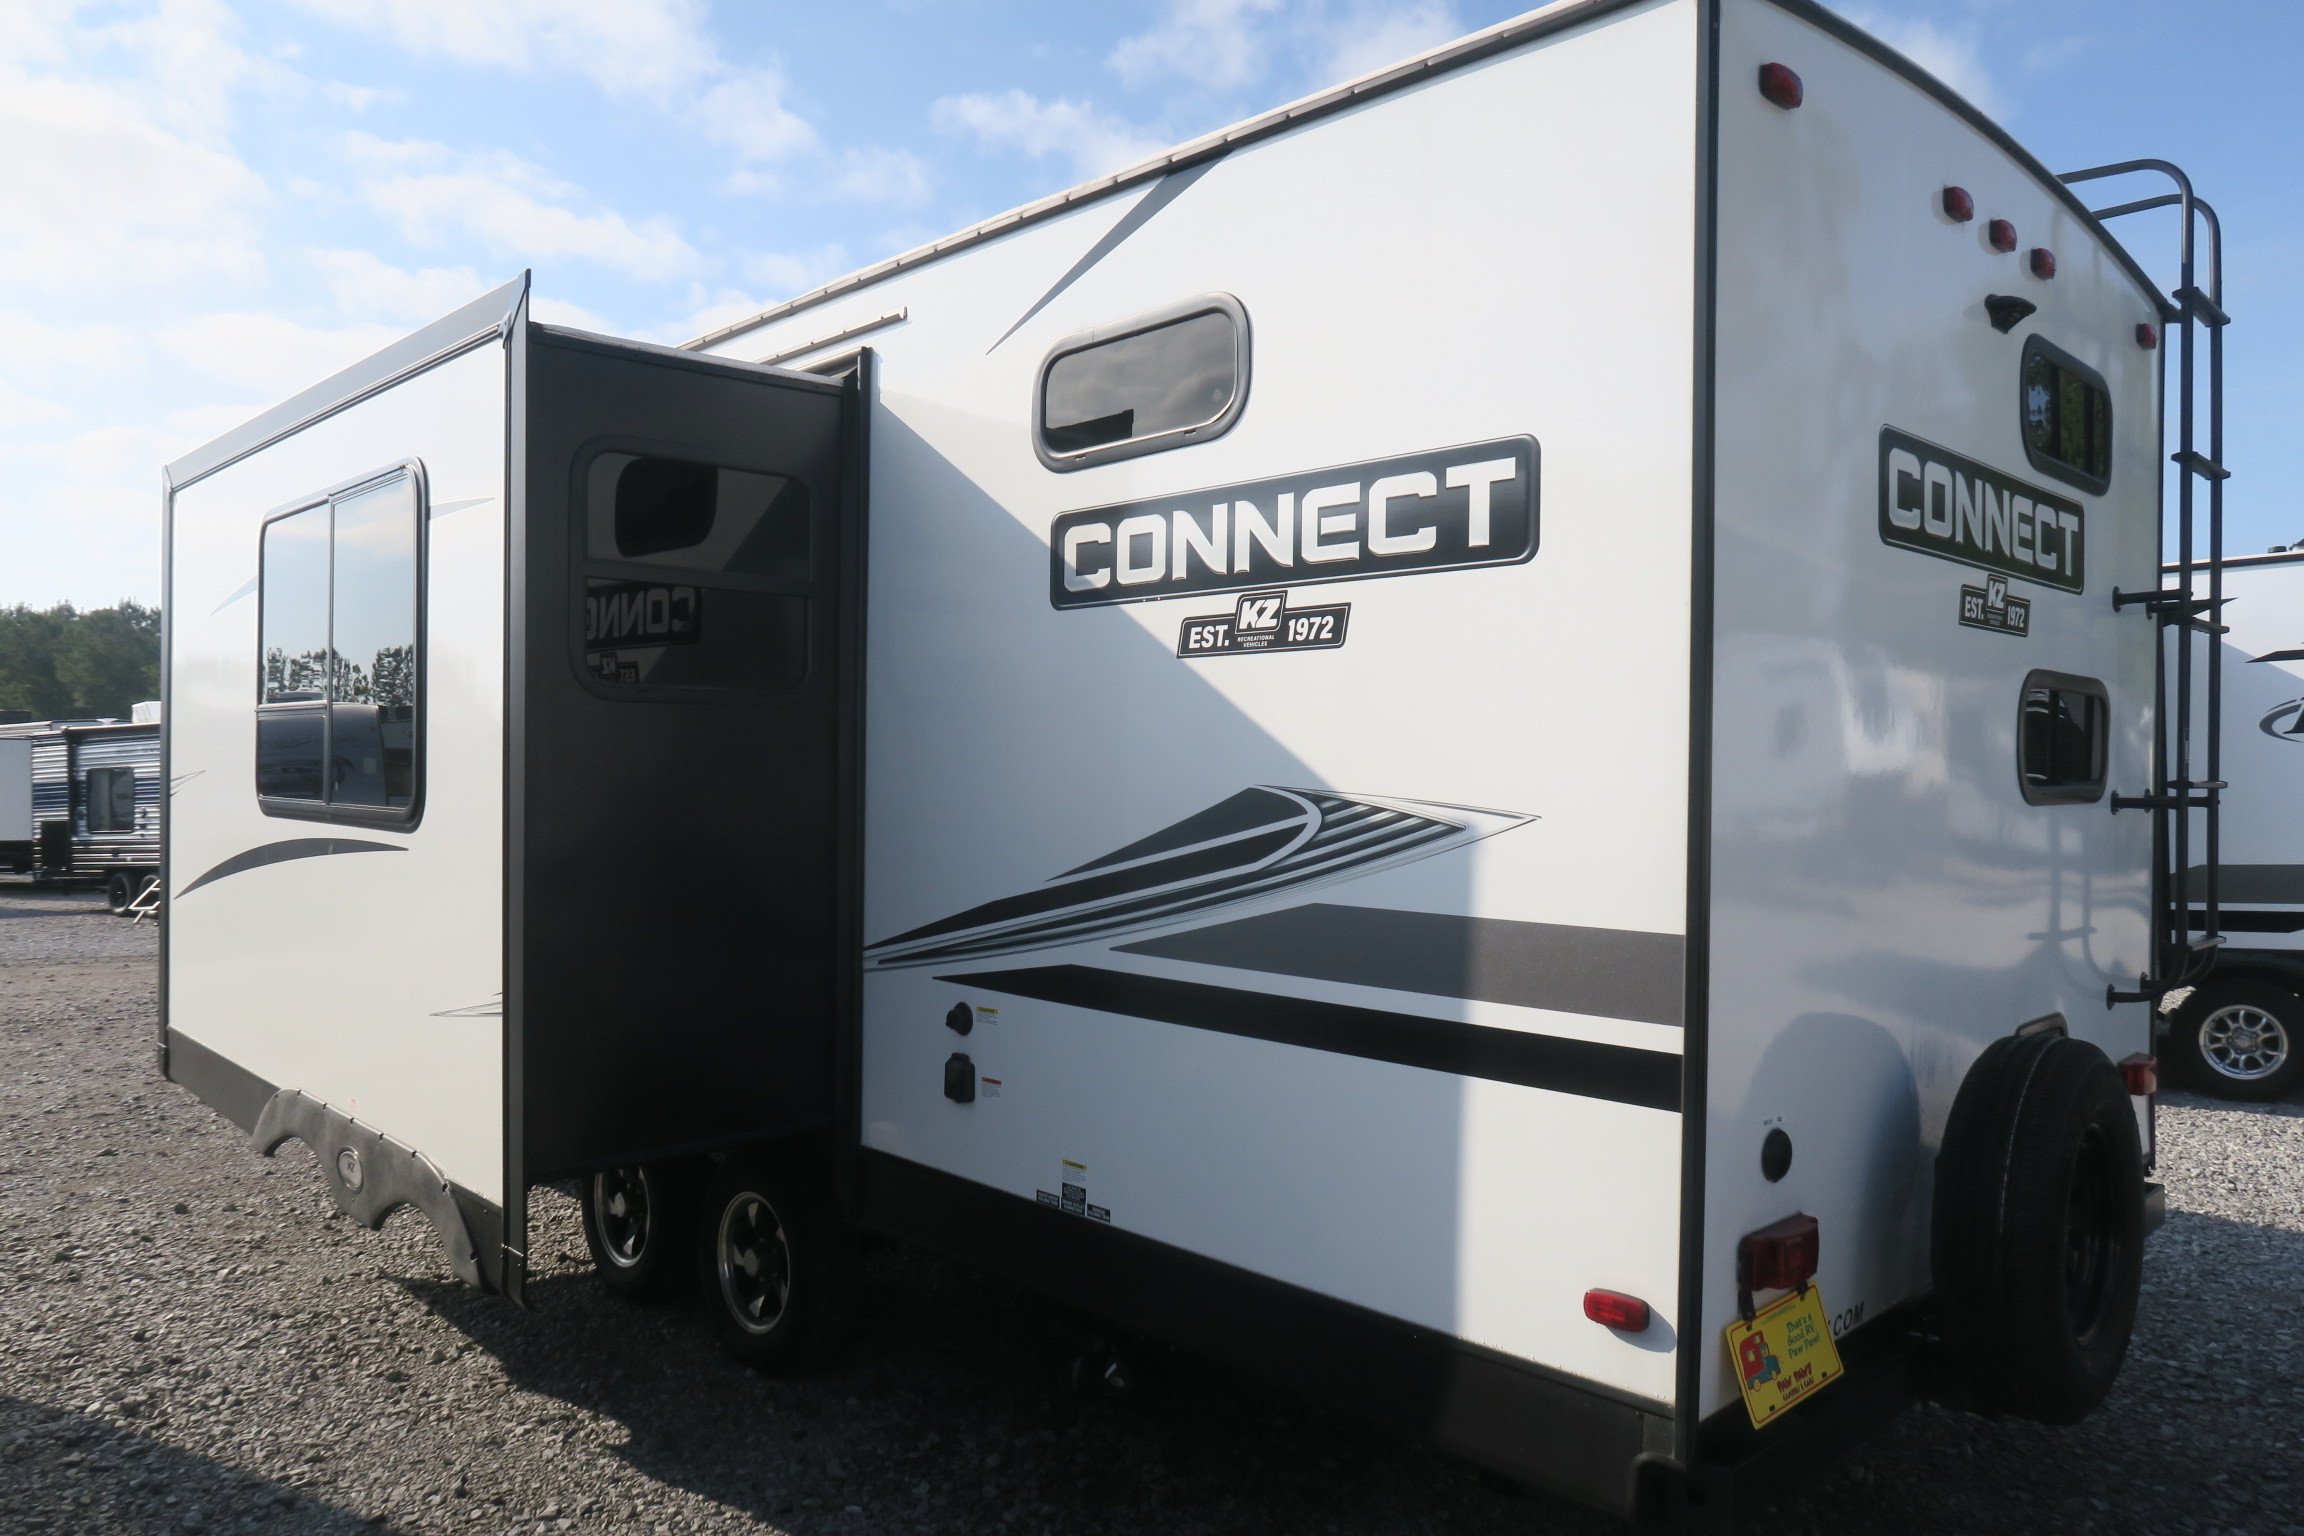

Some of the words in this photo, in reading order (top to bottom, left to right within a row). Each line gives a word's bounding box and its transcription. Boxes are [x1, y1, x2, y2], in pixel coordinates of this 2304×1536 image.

[1064, 456, 1516, 592] CONNECT
[1889, 447, 2079, 576] CONNECT
[1987, 581, 2005, 609] KZ
[1239, 598, 1281, 629] KZ
[1965, 595, 1984, 620] EST.
[2007, 605, 2025, 628] 1972
[1189, 624, 1230, 649] EST.
[1288, 615, 1334, 642] 1972
[1237, 634, 1275, 643] RECREATIONAL
[1243, 640, 1268, 648] VEHICLES
